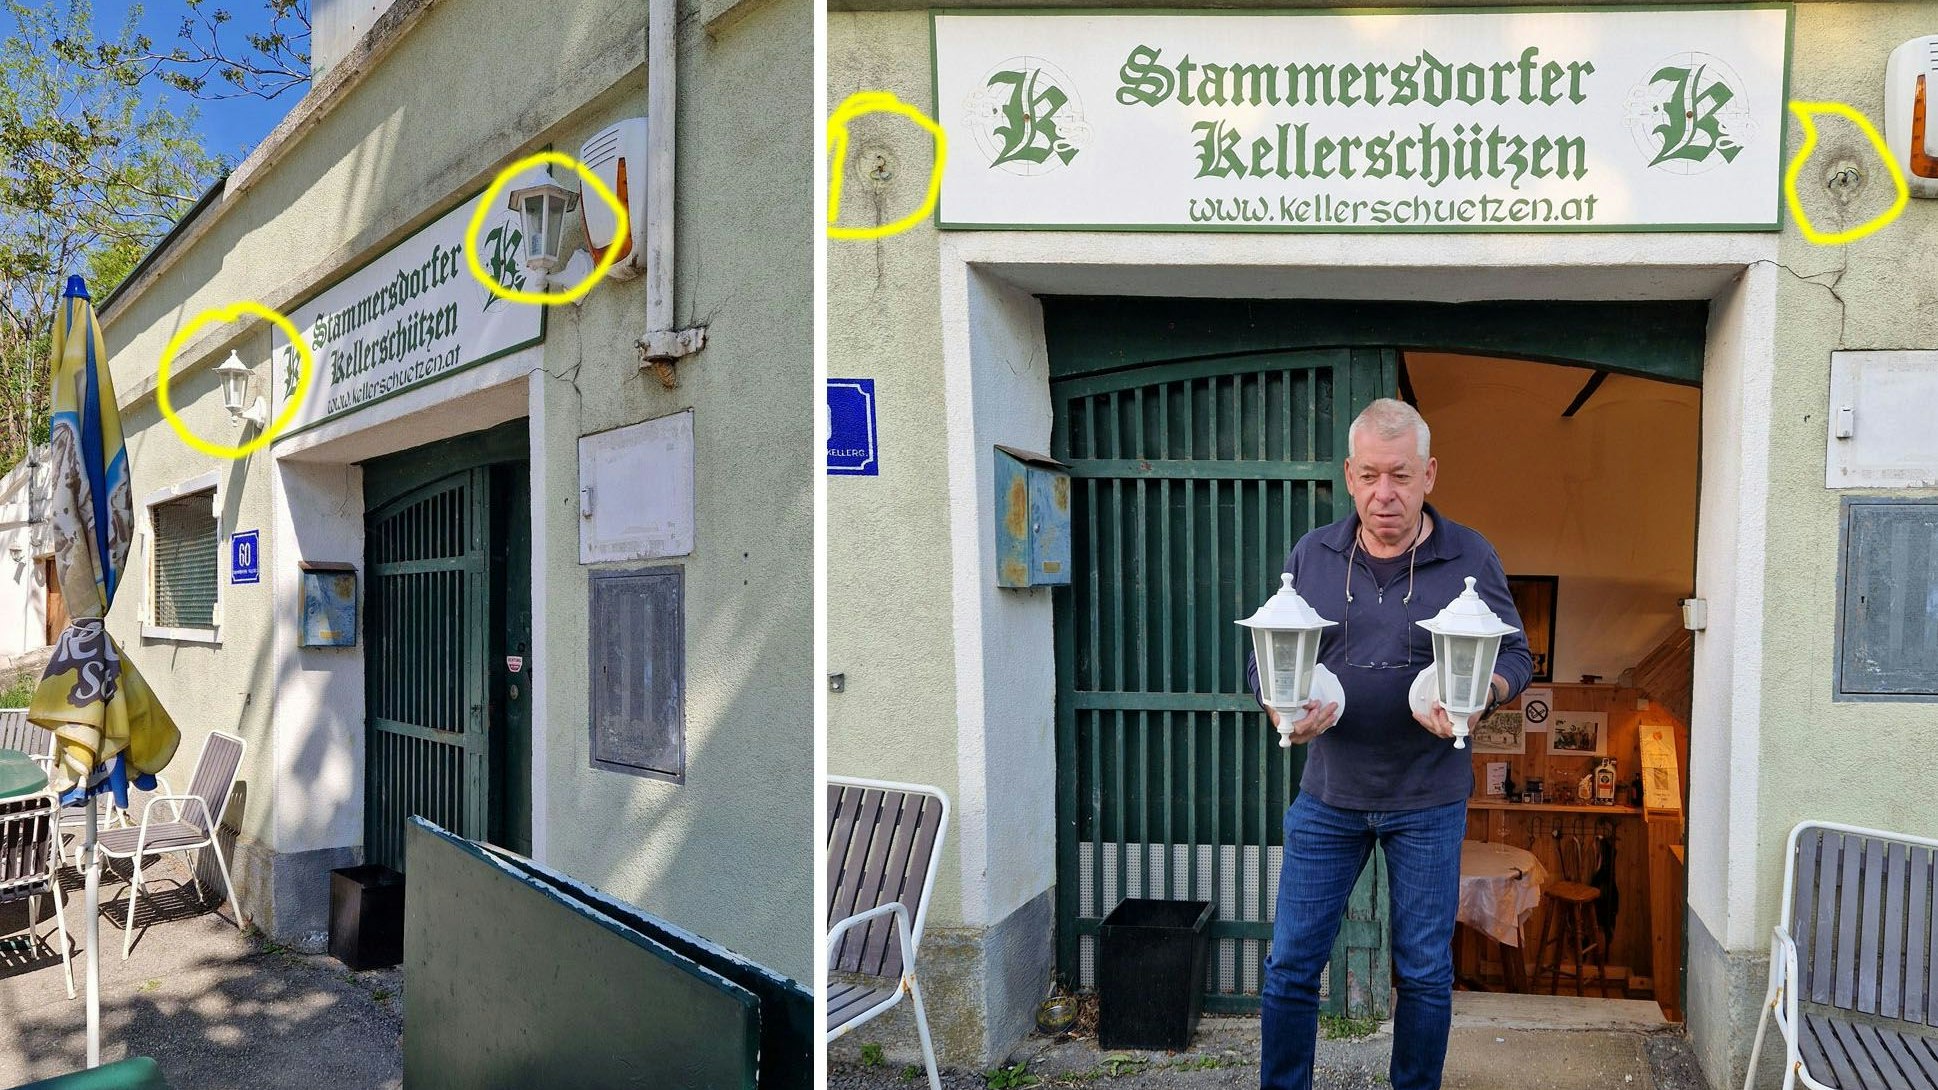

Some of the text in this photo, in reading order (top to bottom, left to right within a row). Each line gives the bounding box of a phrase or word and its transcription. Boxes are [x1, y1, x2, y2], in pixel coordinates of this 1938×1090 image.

[1116, 45, 1595, 107] Stammersdorfer
[1191, 119, 1589, 190] Kellerschützen
[1189, 194, 1599, 223] www.kellerschuetzen.at
[311, 243, 463, 351] Stammersdorfer
[327, 344, 462, 415] www.kellerschuetzen.at
[330, 301, 459, 389] Kellerschützen
[239, 542, 251, 567] 60
